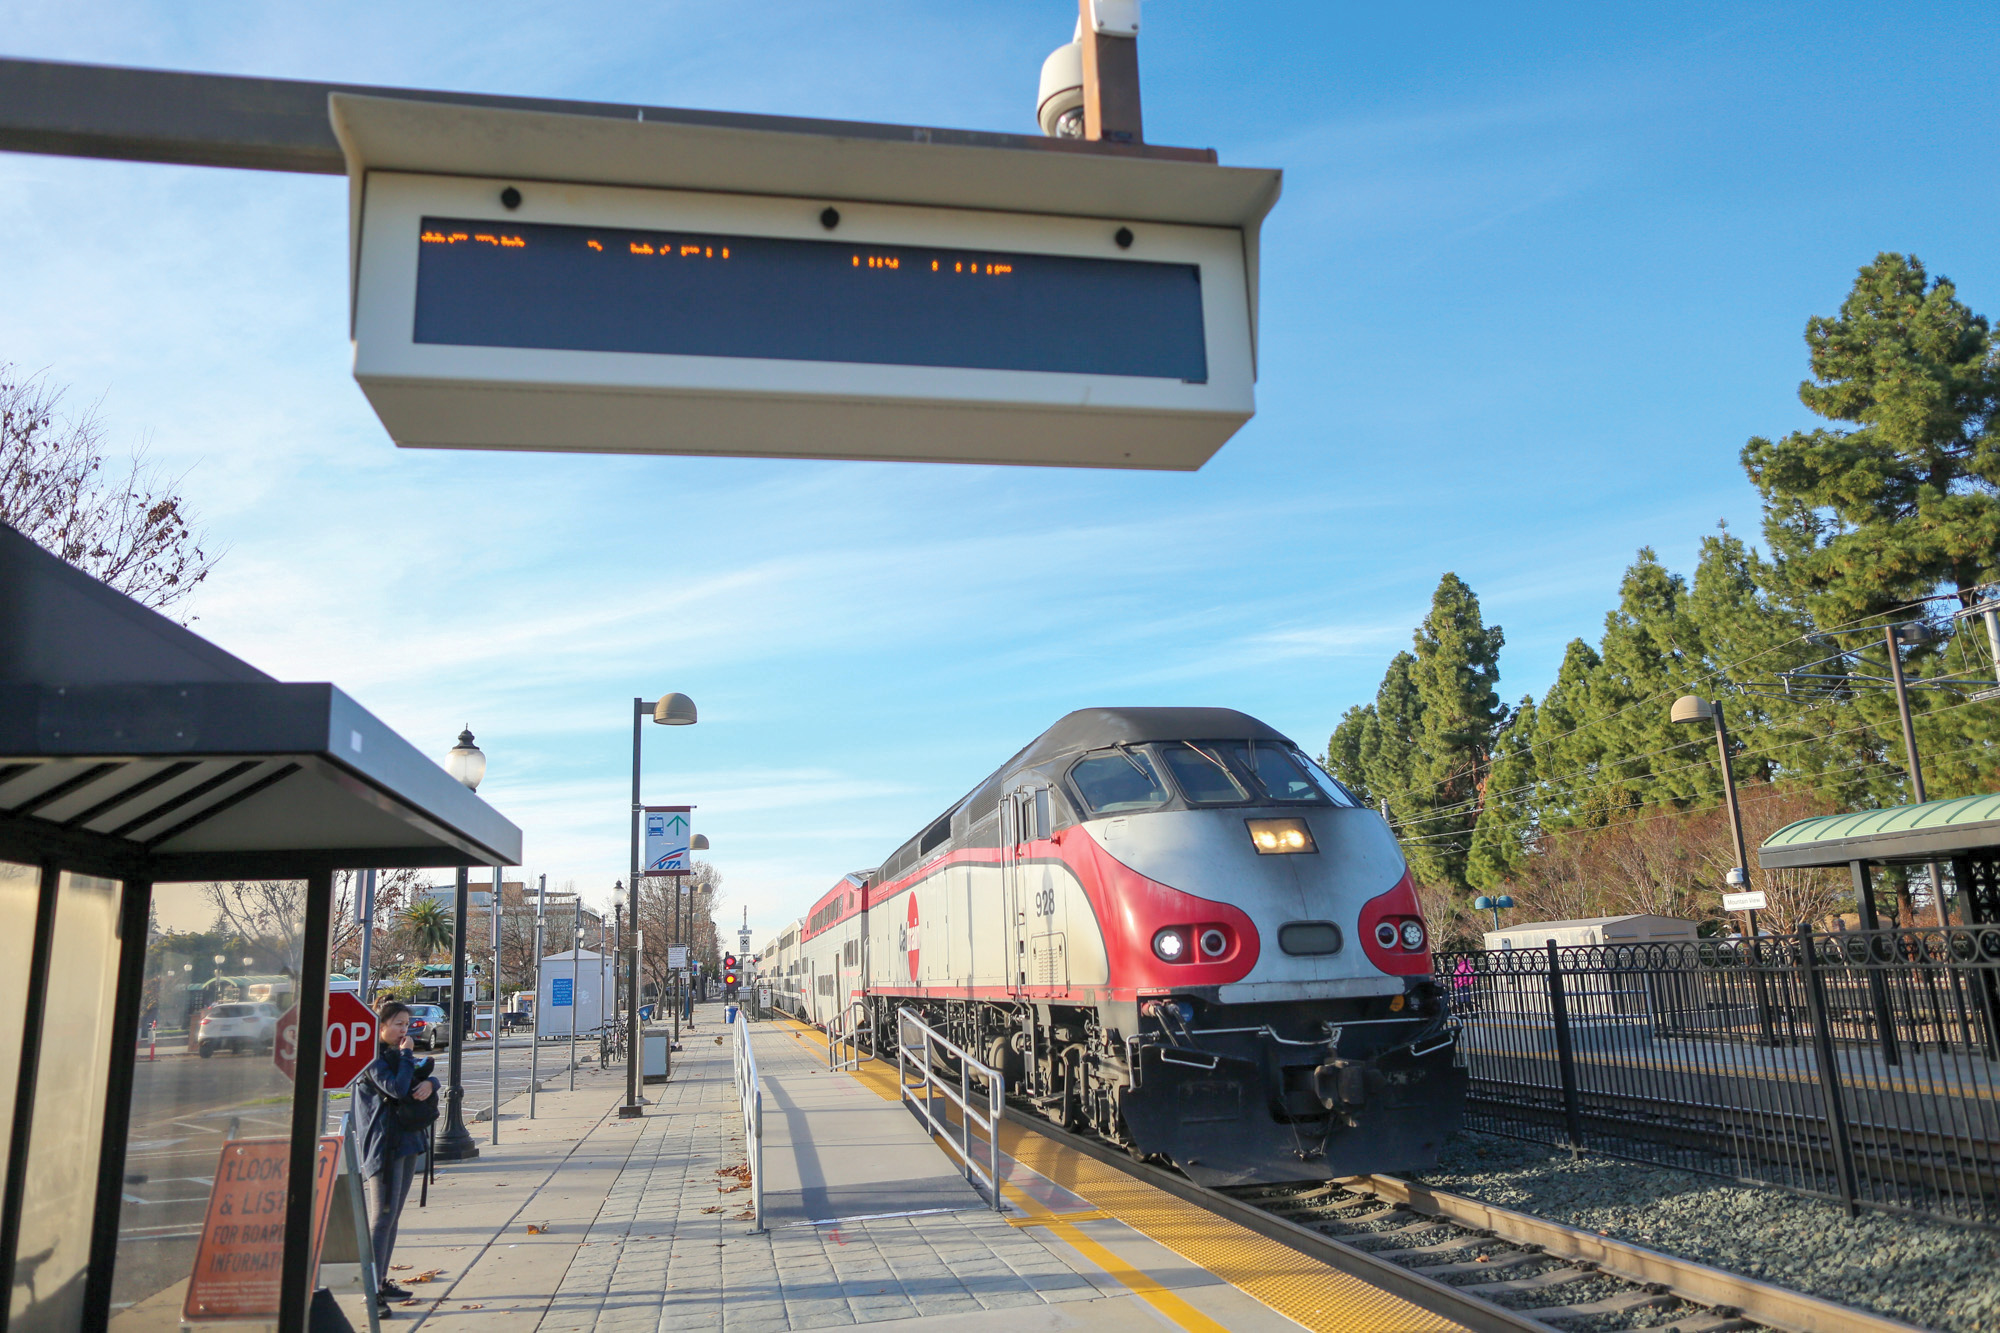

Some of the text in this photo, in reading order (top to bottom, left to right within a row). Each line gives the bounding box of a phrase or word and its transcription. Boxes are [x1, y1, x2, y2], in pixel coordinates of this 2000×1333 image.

[658, 860, 681, 870] VTA
[1035, 888, 1055, 918] 928
[280, 1022, 371, 1060] SOP
[236, 1157, 287, 1182] LOOK
[212, 1225, 239, 1245] FOR
